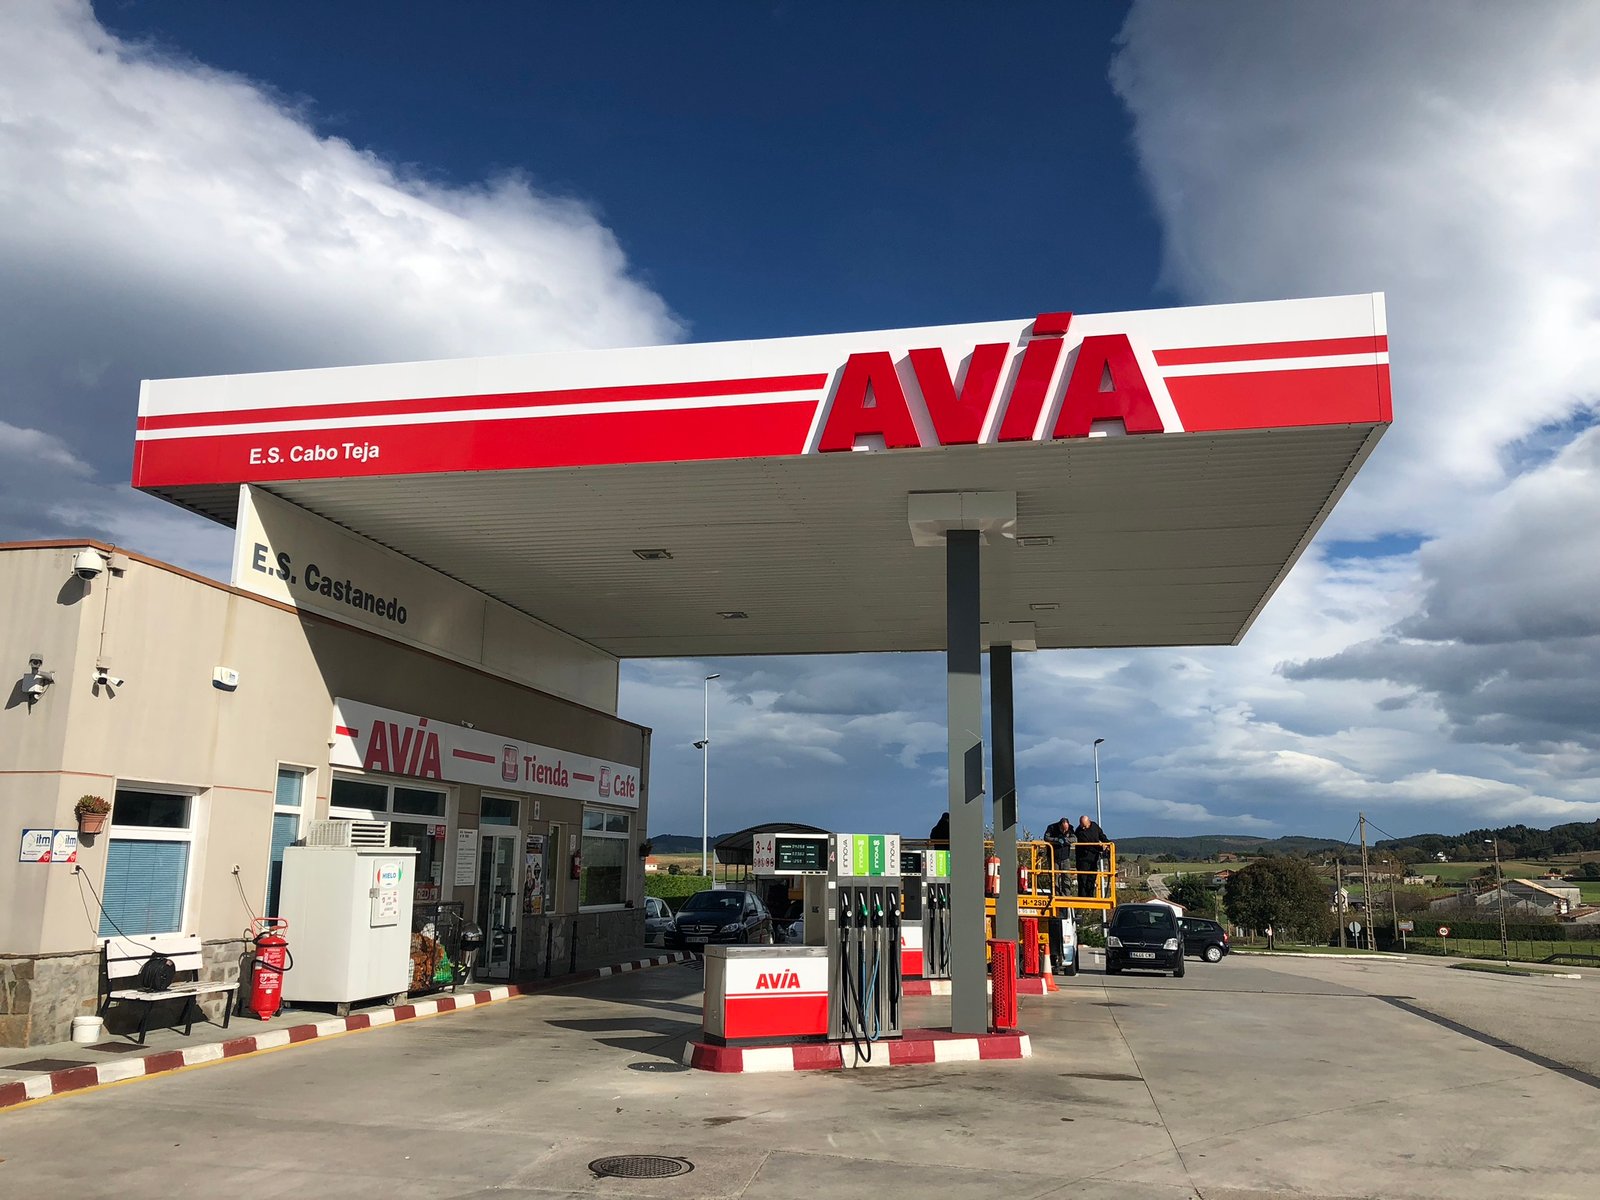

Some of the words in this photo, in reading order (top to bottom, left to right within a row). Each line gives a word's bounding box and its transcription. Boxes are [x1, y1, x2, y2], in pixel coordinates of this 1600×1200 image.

[249, 447, 285, 465] E.S.
[289, 445, 339, 463] Cabo
[342, 442, 380, 463] Teja
[252, 542, 297, 585] E.S.
[304, 563, 408, 625] Castanedo
[523, 755, 570, 788] Tienda
[613, 774, 636, 799] Café
[828, 850, 837, 863] 4
